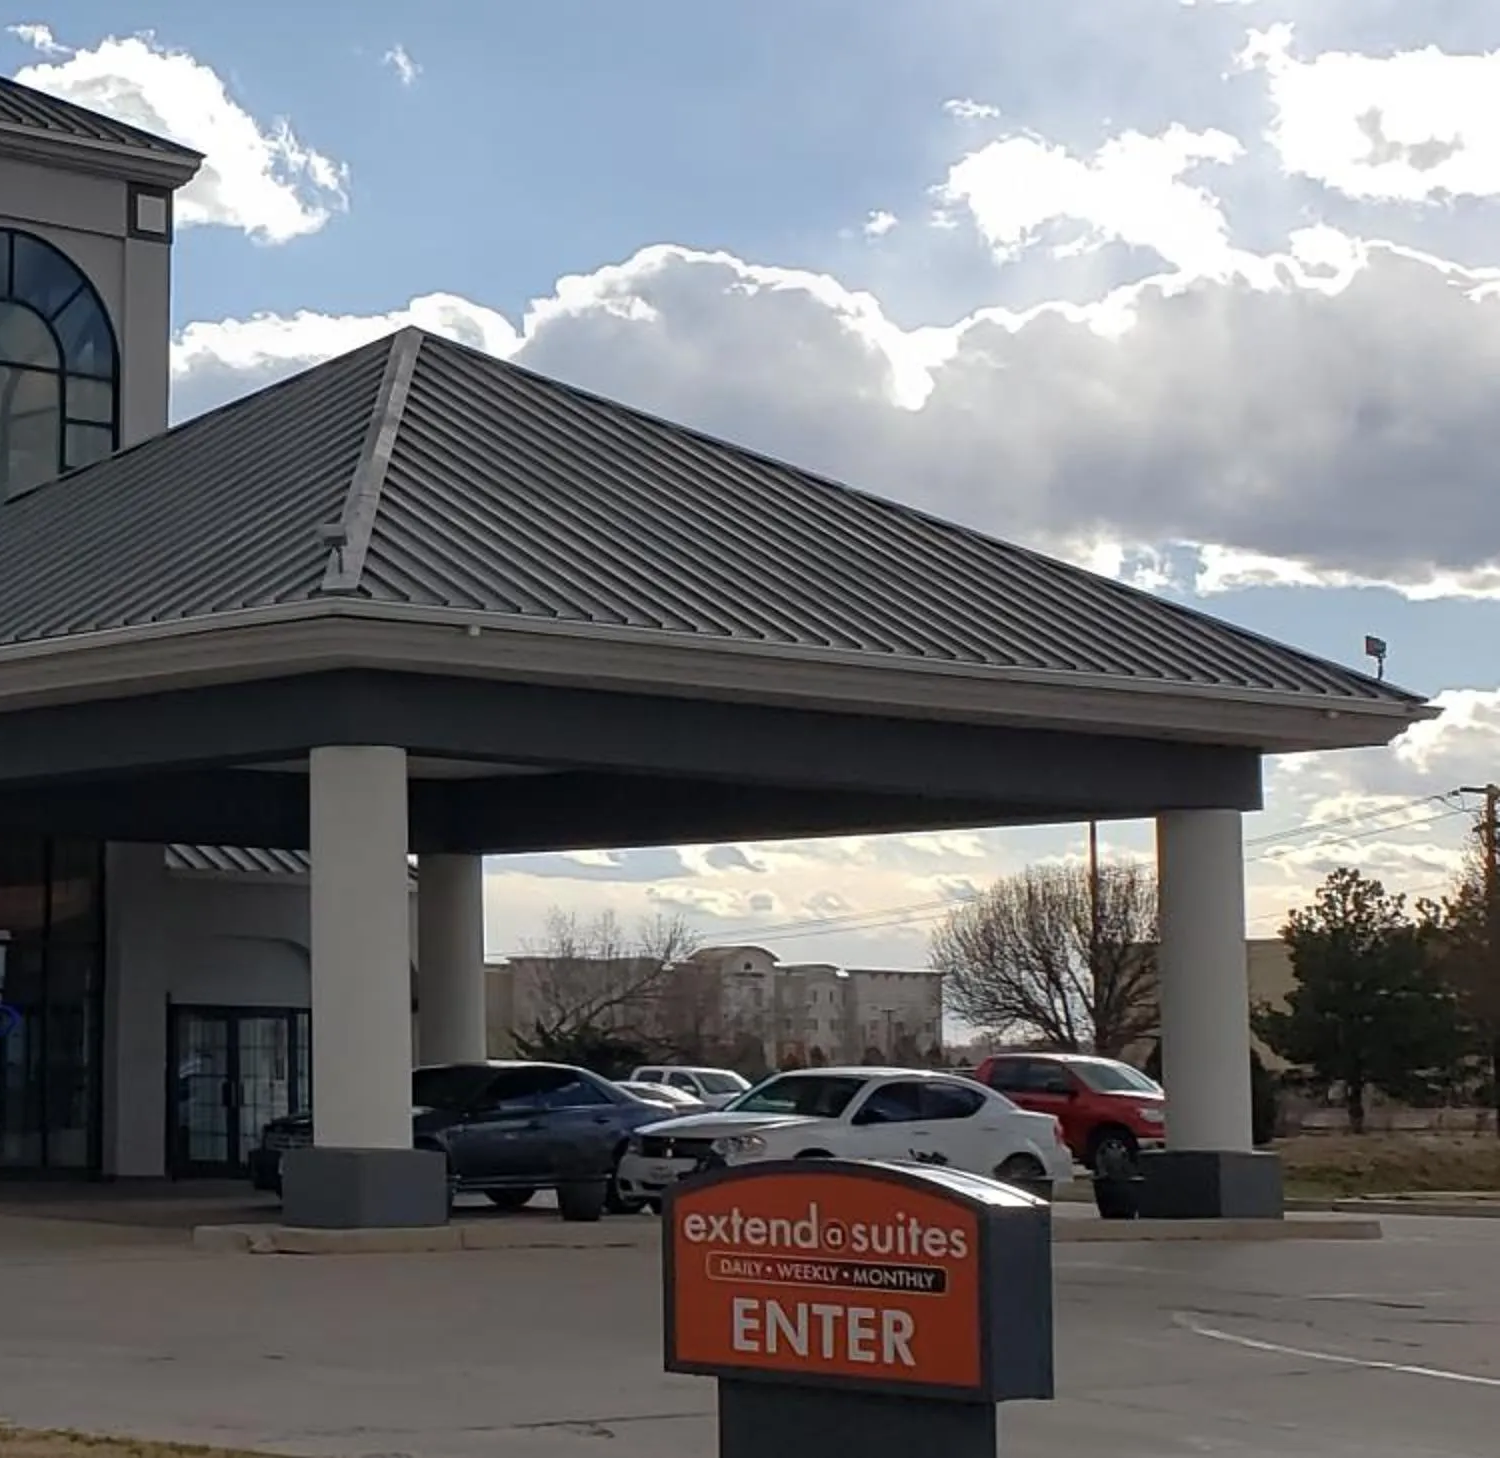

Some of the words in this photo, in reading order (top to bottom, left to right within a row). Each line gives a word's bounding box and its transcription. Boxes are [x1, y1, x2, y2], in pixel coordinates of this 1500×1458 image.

[719, 1258, 764, 1278] DAILY
[775, 1262, 839, 1282] WEEKLY
[852, 1267, 935, 1290] MONTHLY
[732, 1295, 917, 1368] ENTER
